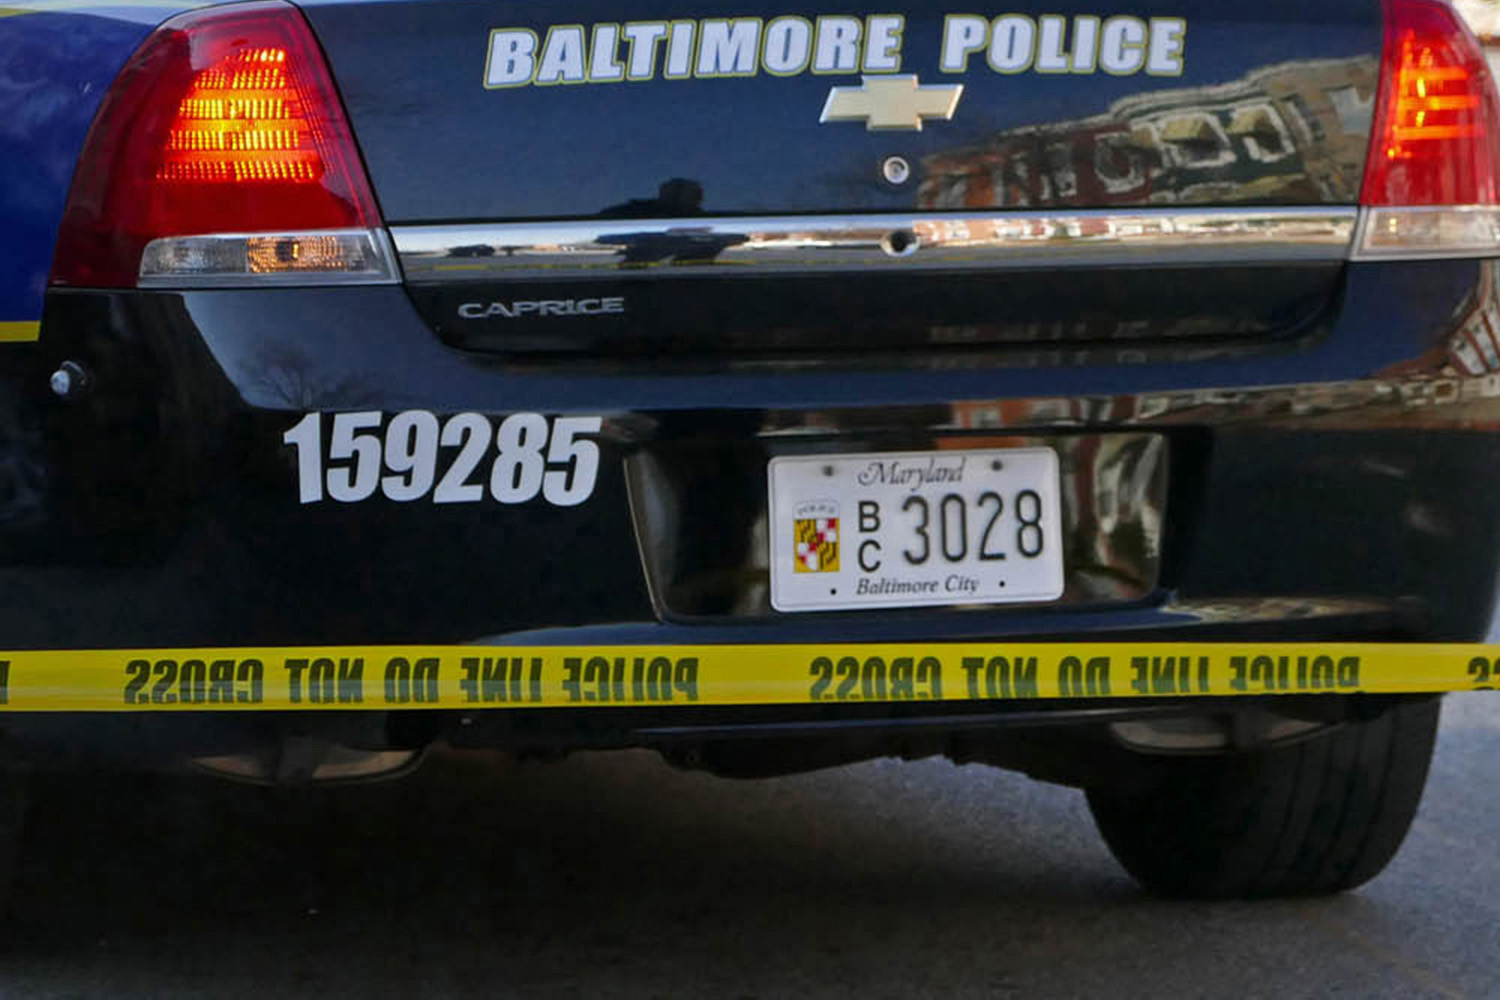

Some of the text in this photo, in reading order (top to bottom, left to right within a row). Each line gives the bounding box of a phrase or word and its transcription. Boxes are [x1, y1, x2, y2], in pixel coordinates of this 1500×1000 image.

[484, 13, 1187, 89] BALTIMORE POLICE
[457, 296, 625, 319] CAPRICE
[282, 409, 603, 507] 159285
[857, 456, 967, 491] Maryland
[901, 488, 1045, 567] 3028
[856, 573, 980, 597] Baltimore City
